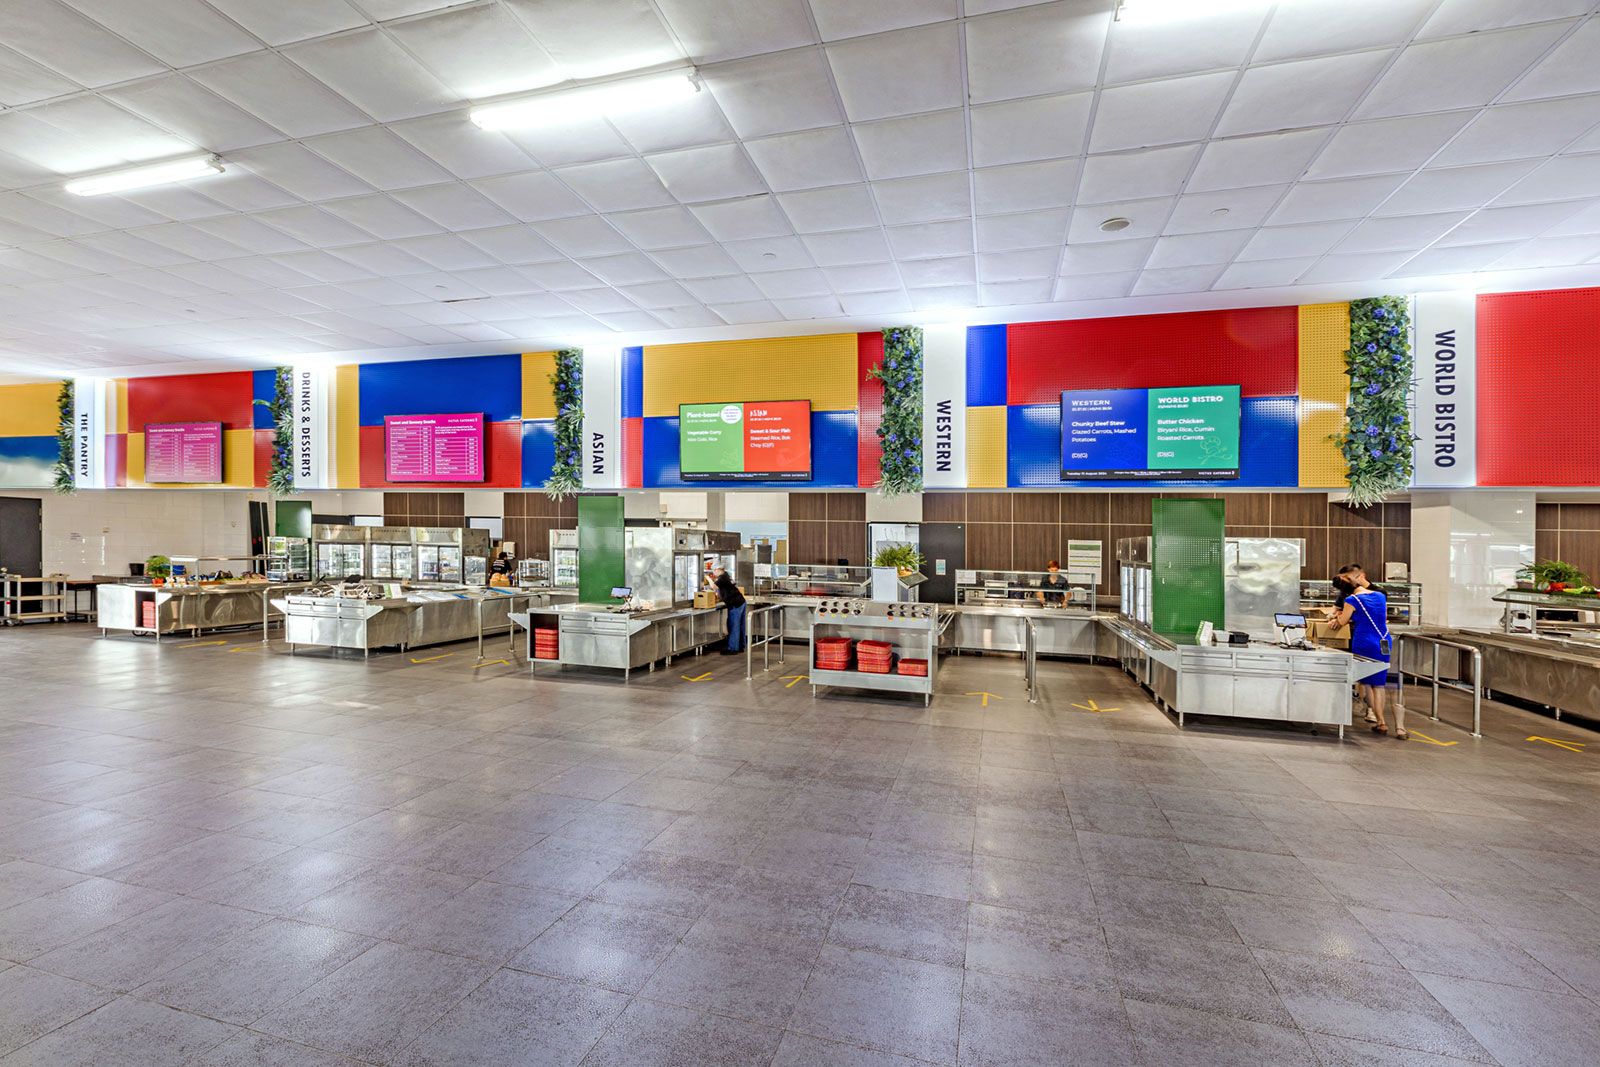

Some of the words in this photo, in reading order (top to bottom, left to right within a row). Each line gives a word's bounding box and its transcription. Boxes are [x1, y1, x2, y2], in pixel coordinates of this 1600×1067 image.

[1434, 329, 1456, 396] WORLD
[302, 372, 310, 412] DRINKS
[302, 428, 310, 478] DESSERTS
[592, 432, 604, 474] ASIAN
[936, 400, 952, 471] WESTERN
[1434, 403, 1456, 468] BISTRO
